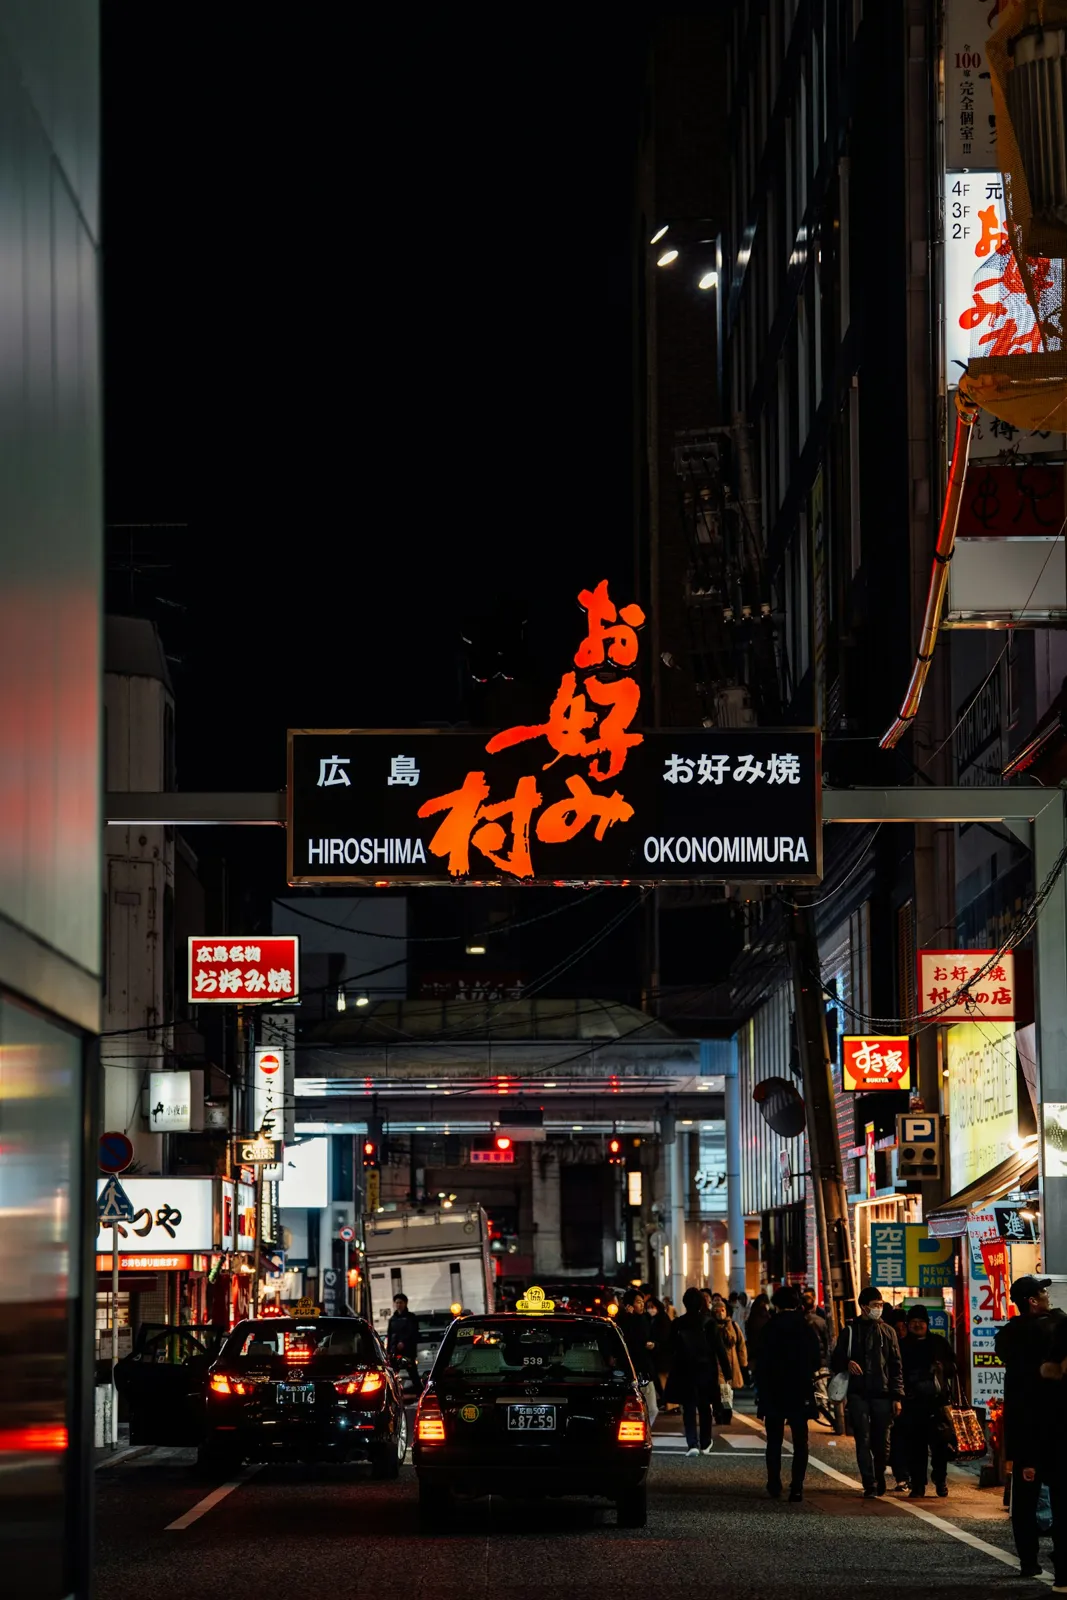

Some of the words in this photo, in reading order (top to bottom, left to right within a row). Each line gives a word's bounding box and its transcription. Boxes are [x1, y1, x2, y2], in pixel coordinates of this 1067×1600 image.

[952, 181, 970, 197] 4F
[952, 202, 970, 218] 3F
[952, 224, 970, 240] 2F
[662, 753, 802, 786] お好み焼
[308, 837, 427, 865] HIROSHIMA
[643, 836, 809, 864] OKONOMIMURA
[196, 945, 262, 963] 広島名物
[194, 968, 293, 993] お好み焼
[851, 1041, 904, 1077] すき家
[905, 1119, 932, 1142] P
[875, 1227, 904, 1285] 空車
[523, 1358, 543, 1366] 539
[518, 1415, 554, 1429] 87-59
